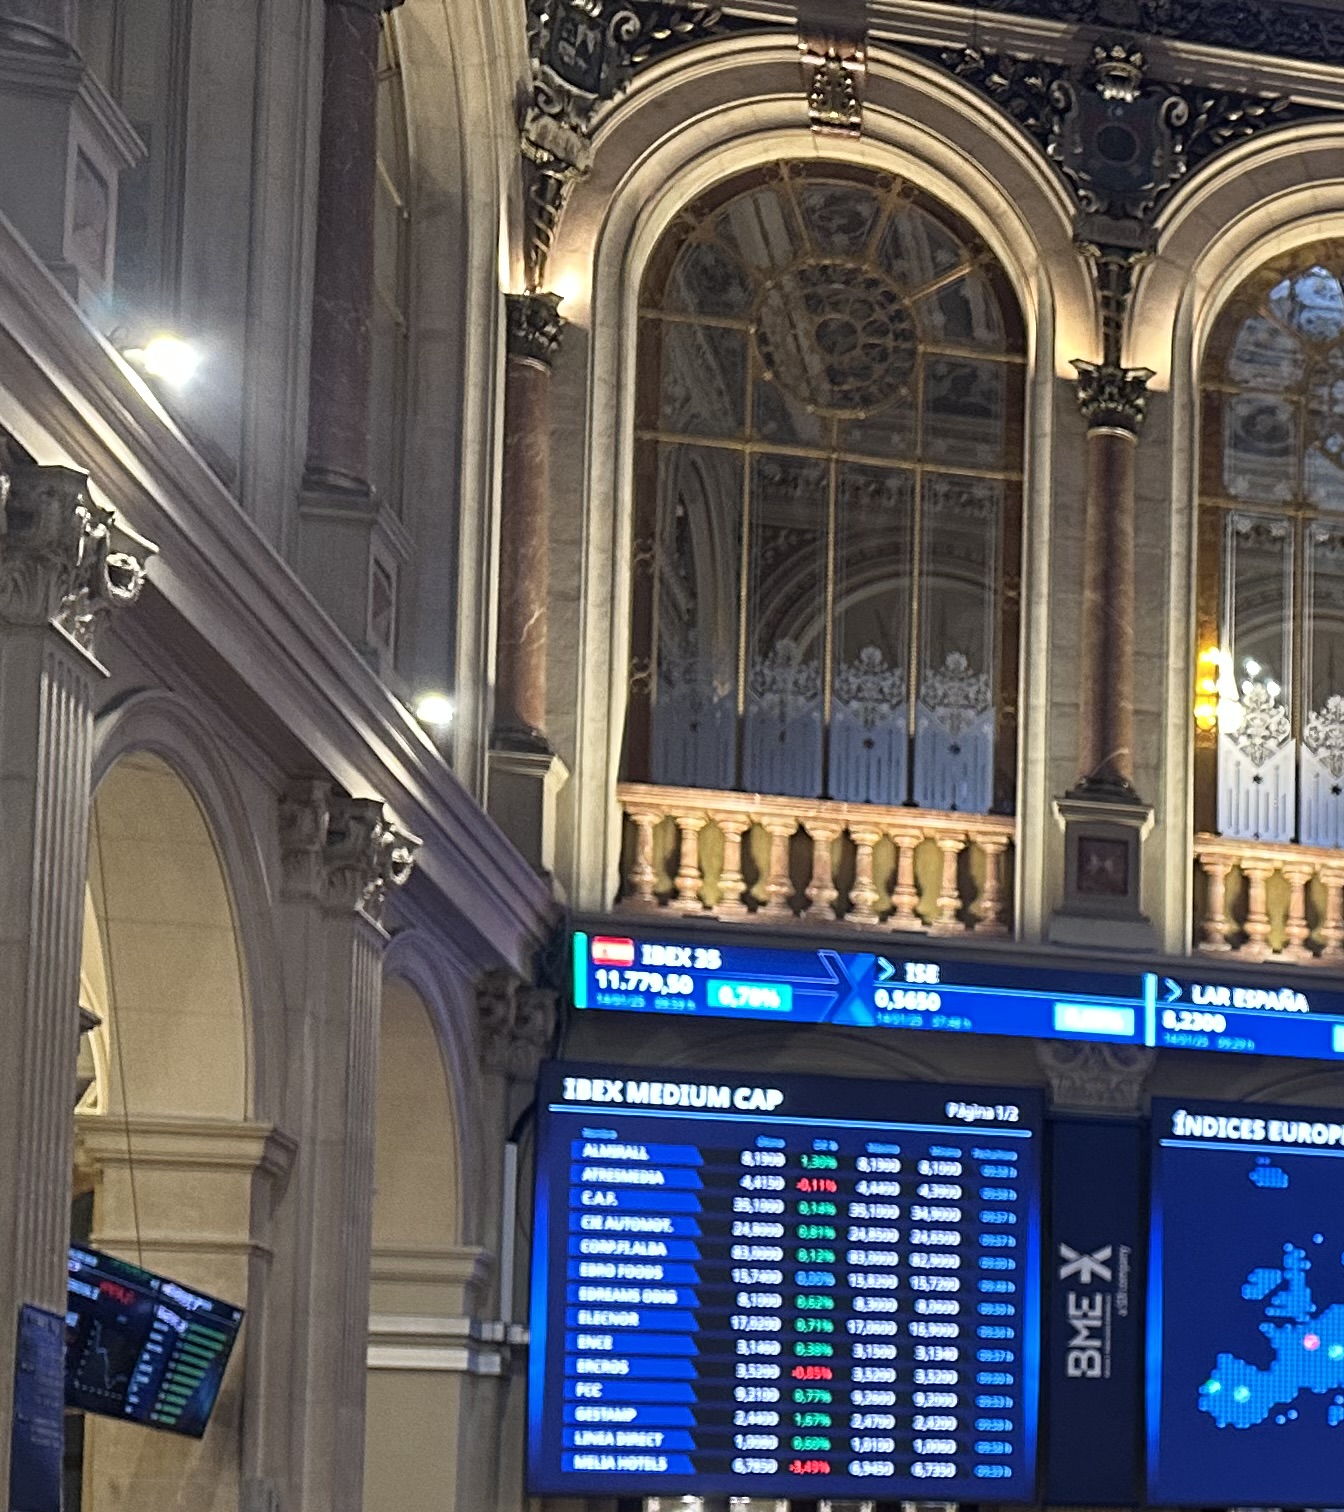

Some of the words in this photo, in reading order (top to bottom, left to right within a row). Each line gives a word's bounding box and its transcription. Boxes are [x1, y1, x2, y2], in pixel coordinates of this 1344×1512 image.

[641, 944, 692, 970] IBEX
[694, 949, 722, 970] 35
[595, 969, 694, 995] 11.779,50
[904, 962, 940, 984] ISE
[874, 988, 942, 1012] 0,5650
[1191, 984, 1231, 1006] LAR
[1232, 987, 1309, 1013] ESPAÑA
[563, 1077, 623, 1103] IBEX
[626, 1081, 731, 1109] MEDIUM
[733, 1087, 784, 1111] CAP
[1171, 1109, 1266, 1140] ÍNDICES
[617, 1263, 664, 1280] FOODS
[1067, 1291, 1102, 1378] BME
